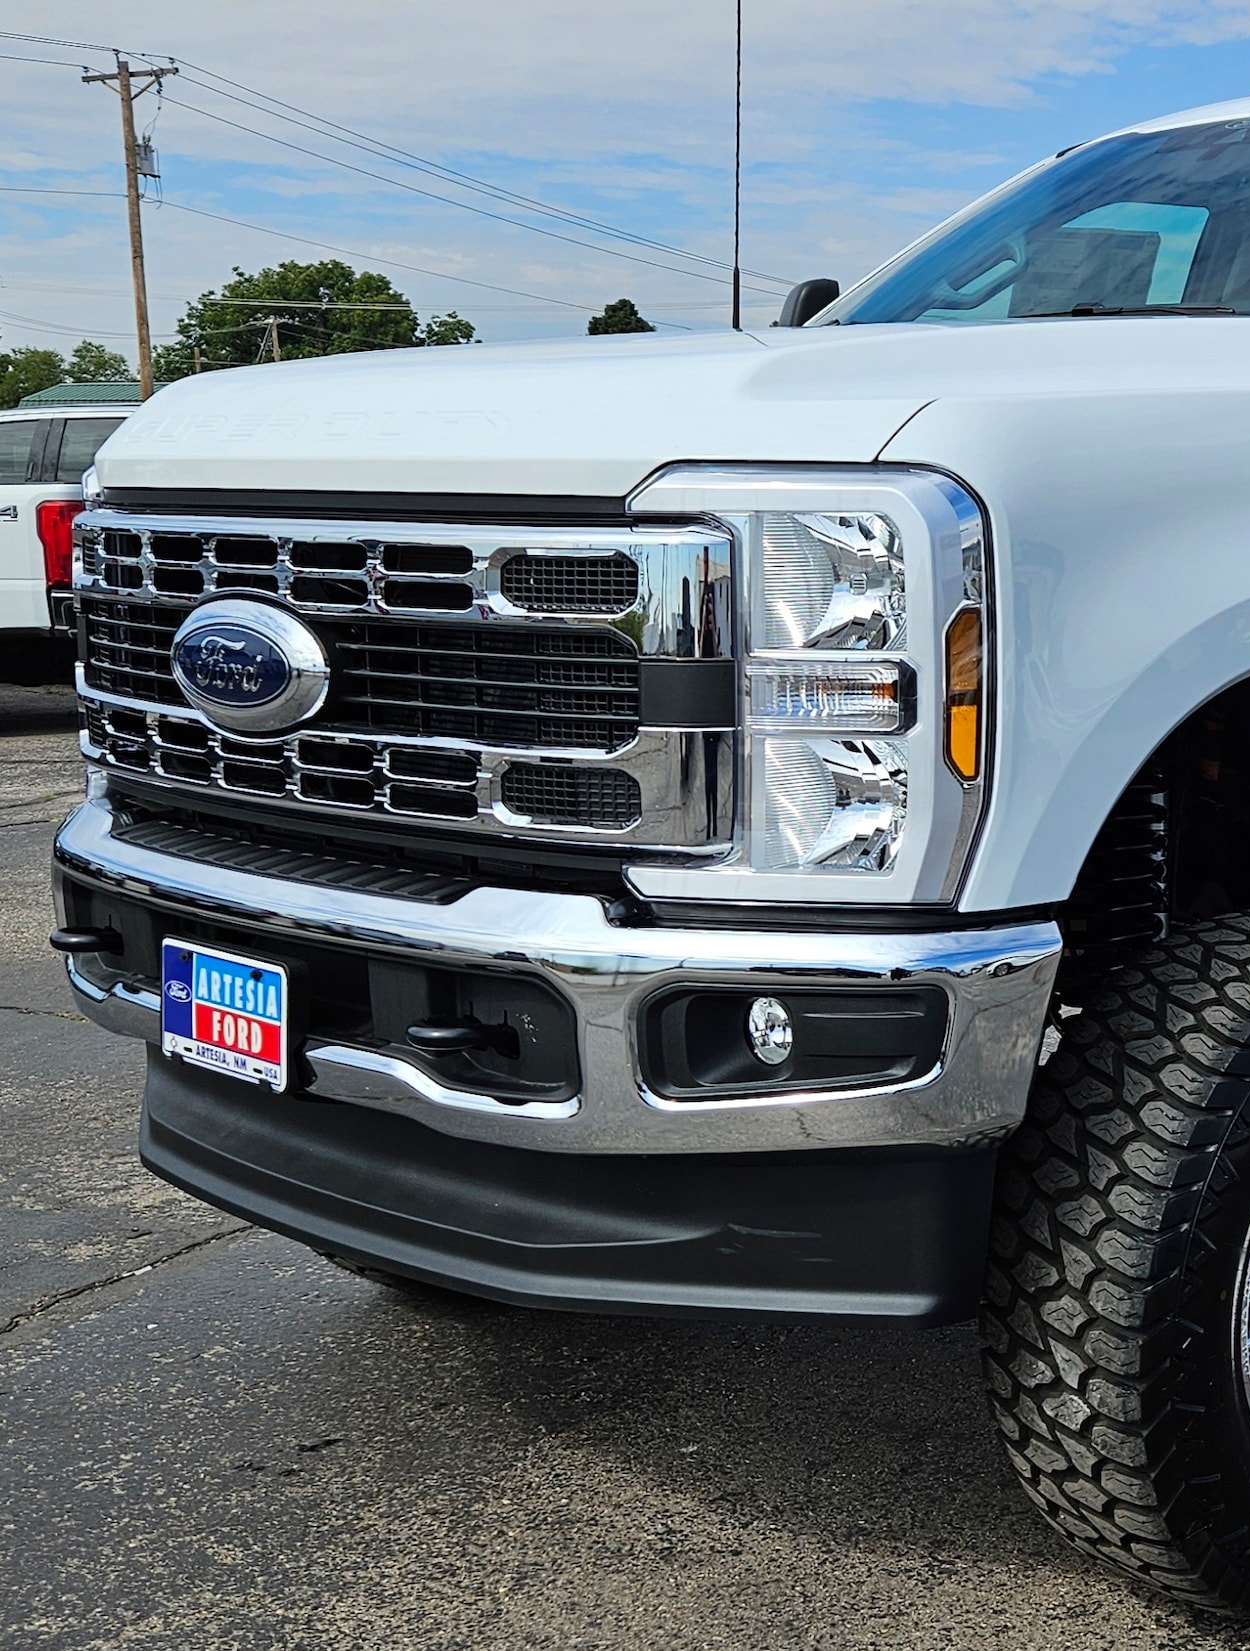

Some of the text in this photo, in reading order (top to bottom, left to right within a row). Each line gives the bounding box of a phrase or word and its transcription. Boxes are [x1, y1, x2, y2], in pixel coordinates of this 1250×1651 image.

[195, 635, 264, 693] Ford
[197, 967, 279, 1019] ARTESIA
[211, 1010, 263, 1054] FORD
[233, 1057, 248, 1071] NM
[263, 1065, 279, 1080] USA
